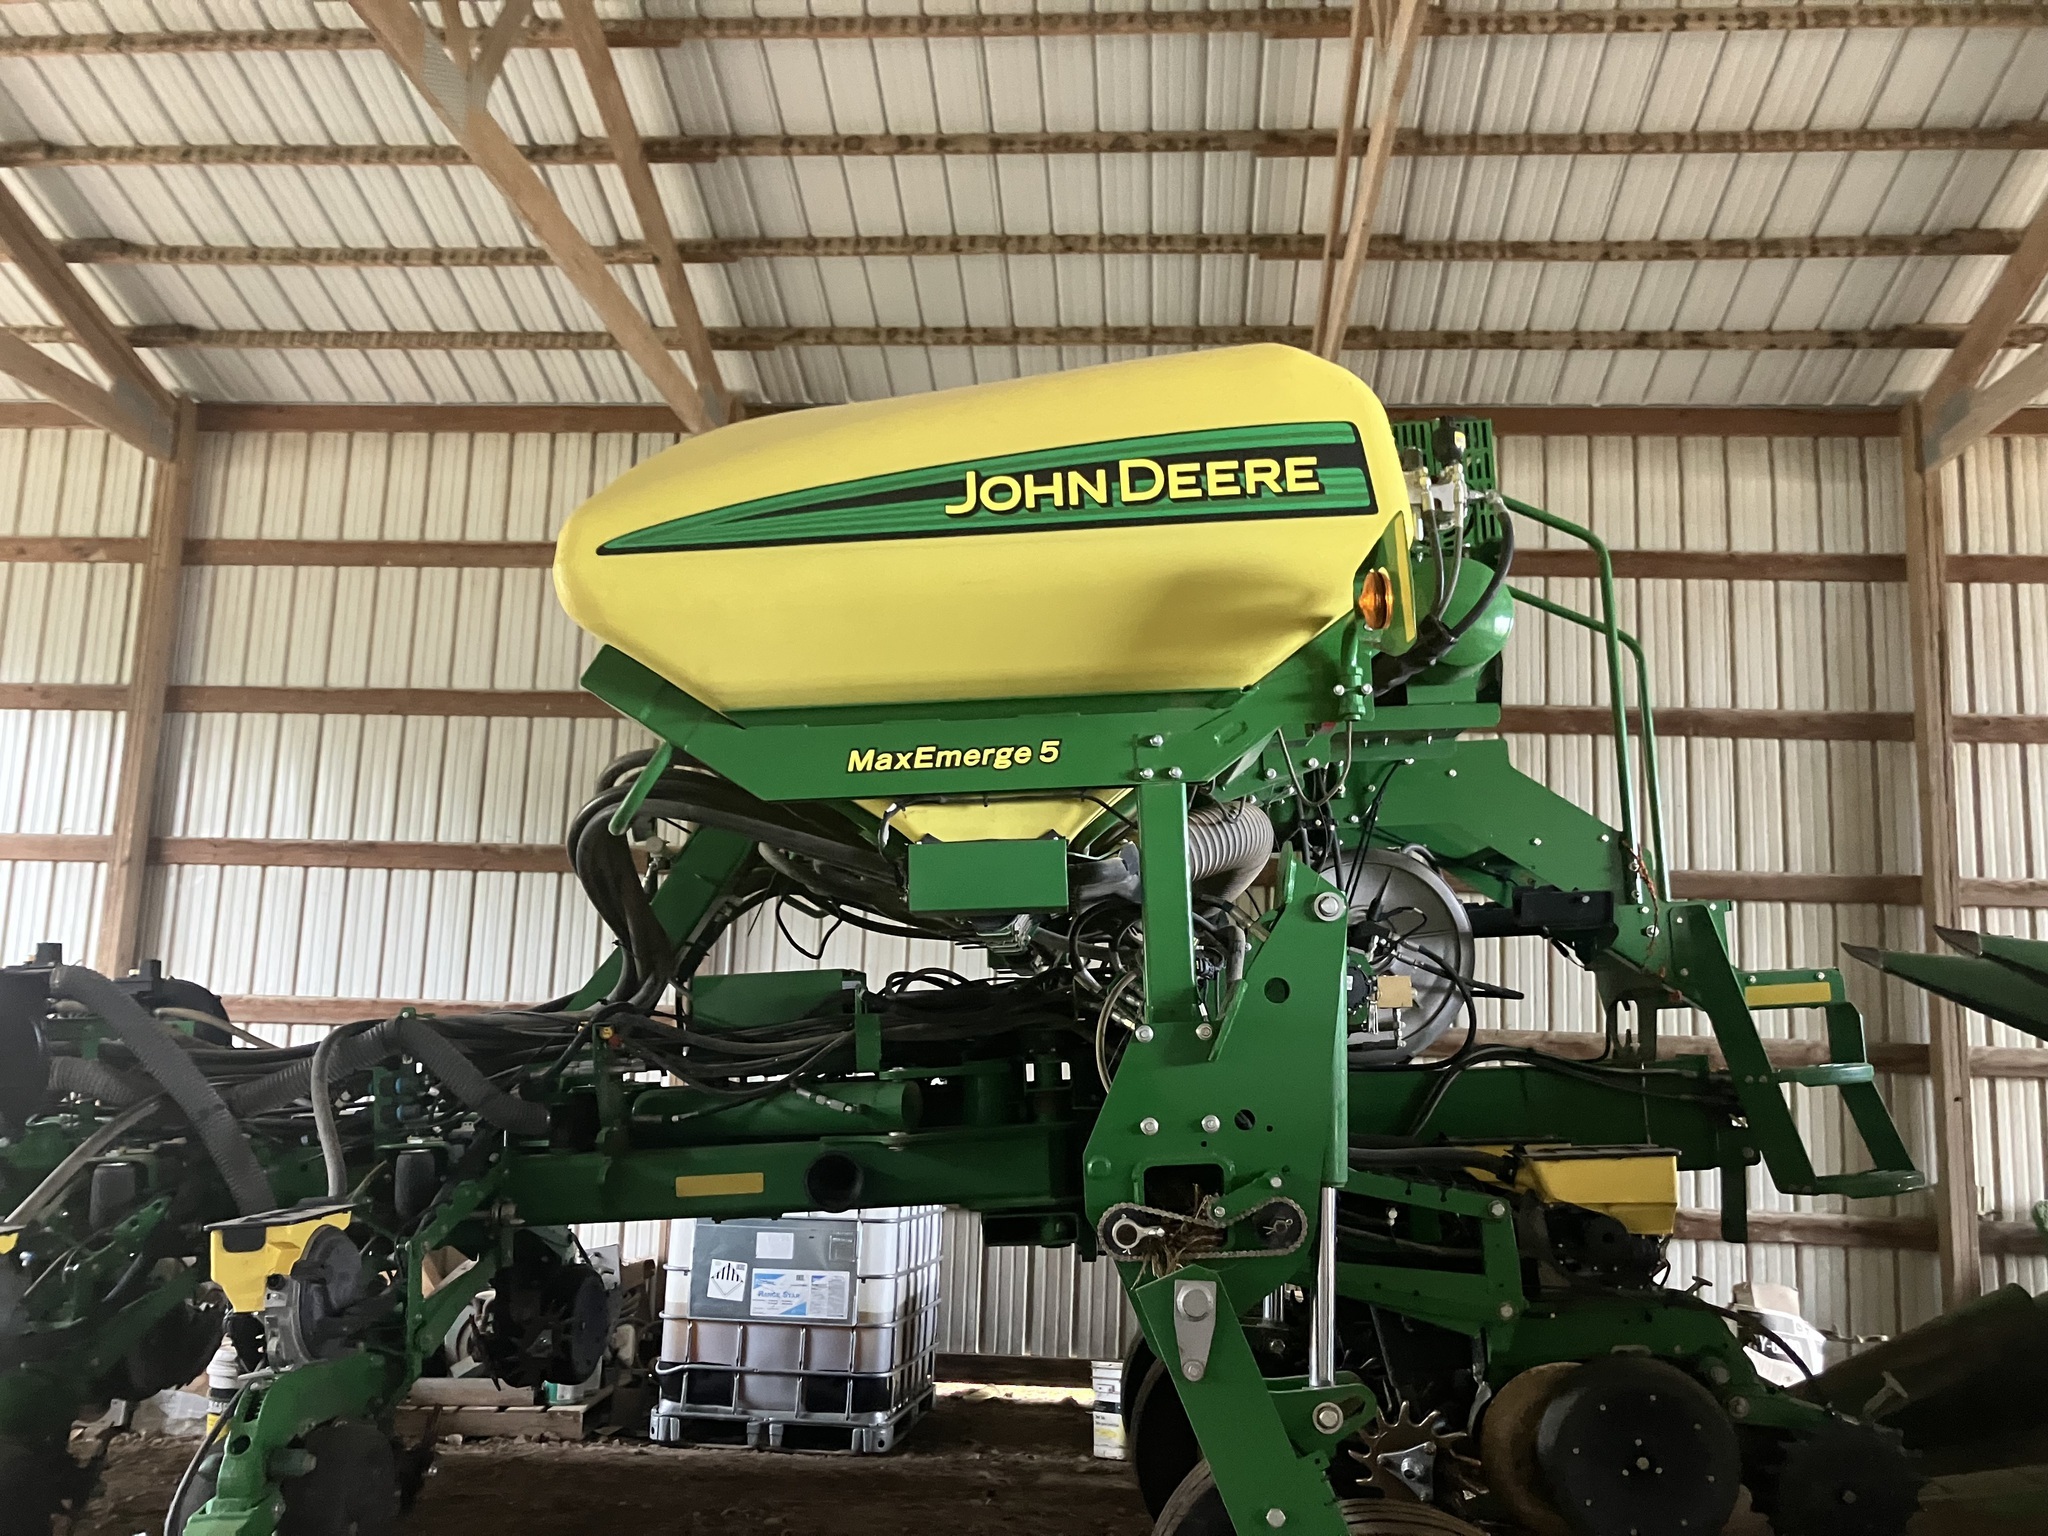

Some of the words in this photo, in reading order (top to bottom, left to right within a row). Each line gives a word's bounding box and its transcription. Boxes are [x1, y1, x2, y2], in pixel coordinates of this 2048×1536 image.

[945, 469, 1108, 516] JOHN
[1118, 456, 1321, 503] DEERE
[846, 746, 1033, 773] MaxEmerge
[1039, 740, 1061, 764] 5
